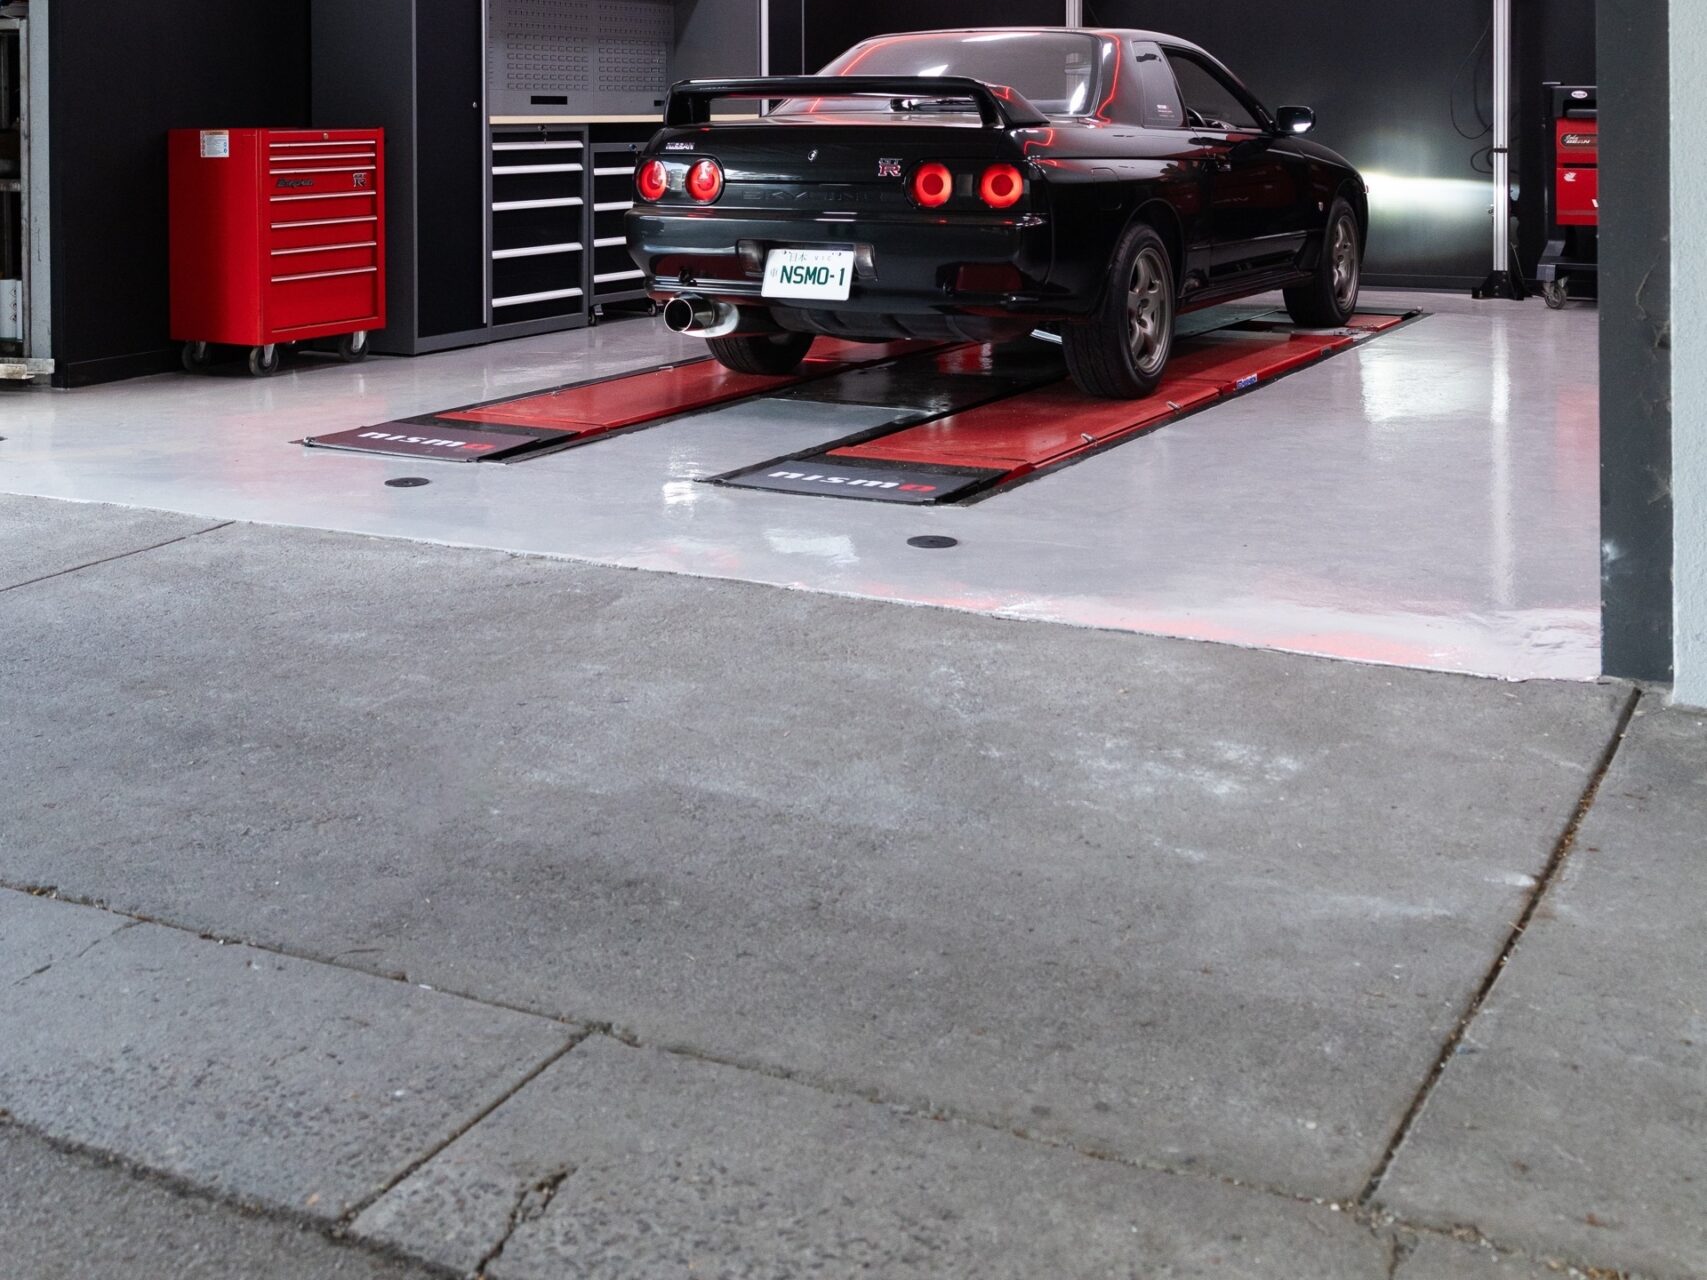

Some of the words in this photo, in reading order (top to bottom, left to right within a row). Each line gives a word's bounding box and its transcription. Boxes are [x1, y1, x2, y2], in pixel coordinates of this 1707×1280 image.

[779, 265, 845, 286] NSMO-1
[357, 431, 497, 452] nismo
[767, 471, 937, 493] nismo
